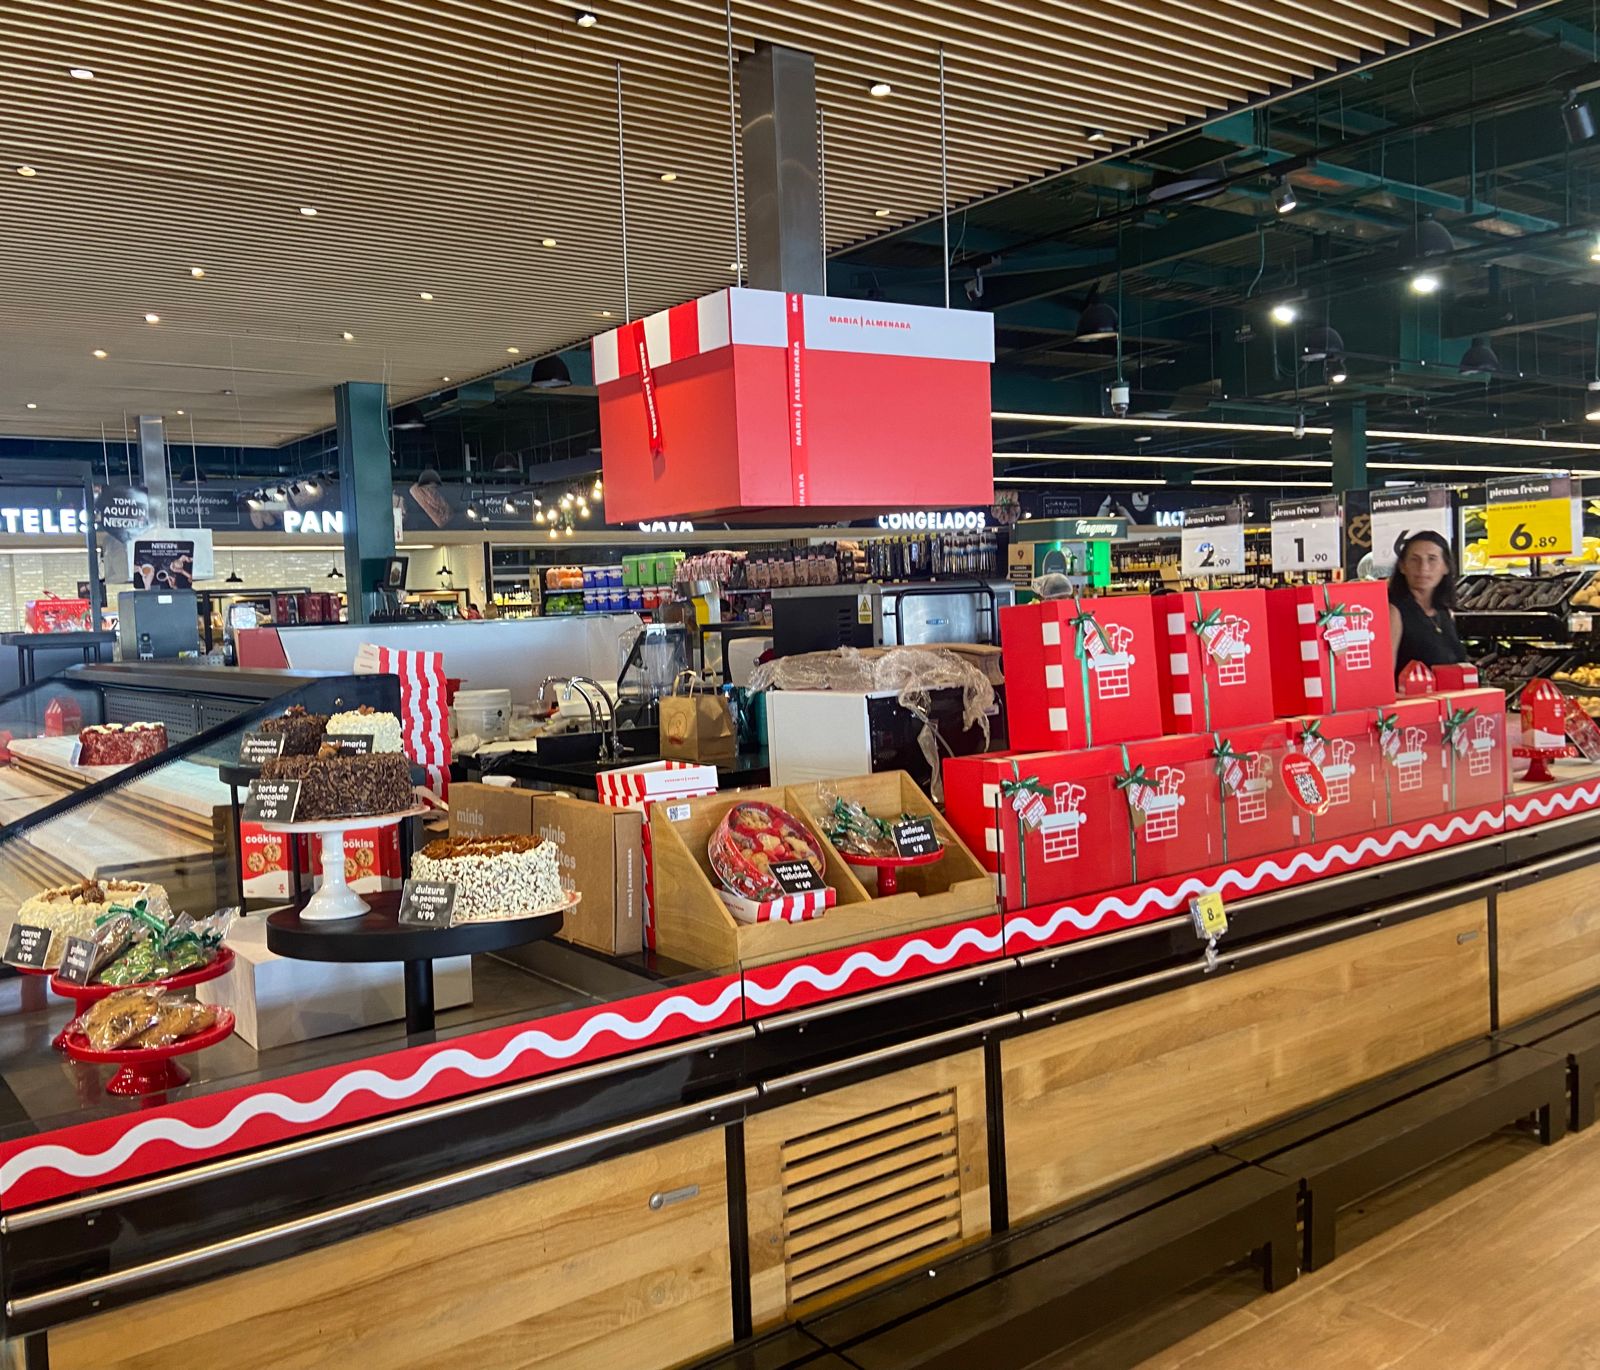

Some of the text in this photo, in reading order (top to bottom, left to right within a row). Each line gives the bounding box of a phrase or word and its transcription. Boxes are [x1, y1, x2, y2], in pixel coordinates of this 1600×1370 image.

[829, 315, 912, 330] MARIA ALMENARA
[793, 341, 801, 401] ALMENARA
[113, 497, 137, 506] TOMA
[131, 507, 146, 517] UN
[1156, 510, 1184, 527] LACT
[0, 508, 98, 533] TELES
[283, 510, 344, 533] PAN
[878, 511, 986, 530] CONGELADOS
[1075, 519, 1118, 537] Tanqueray
[258, 783, 290, 793] torta de
[256, 793, 288, 801] chocolate
[456, 808, 484, 826] minis
[539, 823, 566, 844] minis
[415, 884, 446, 896] dulzura
[20, 929, 42, 939] carrot
[20, 938, 37, 947] cake
